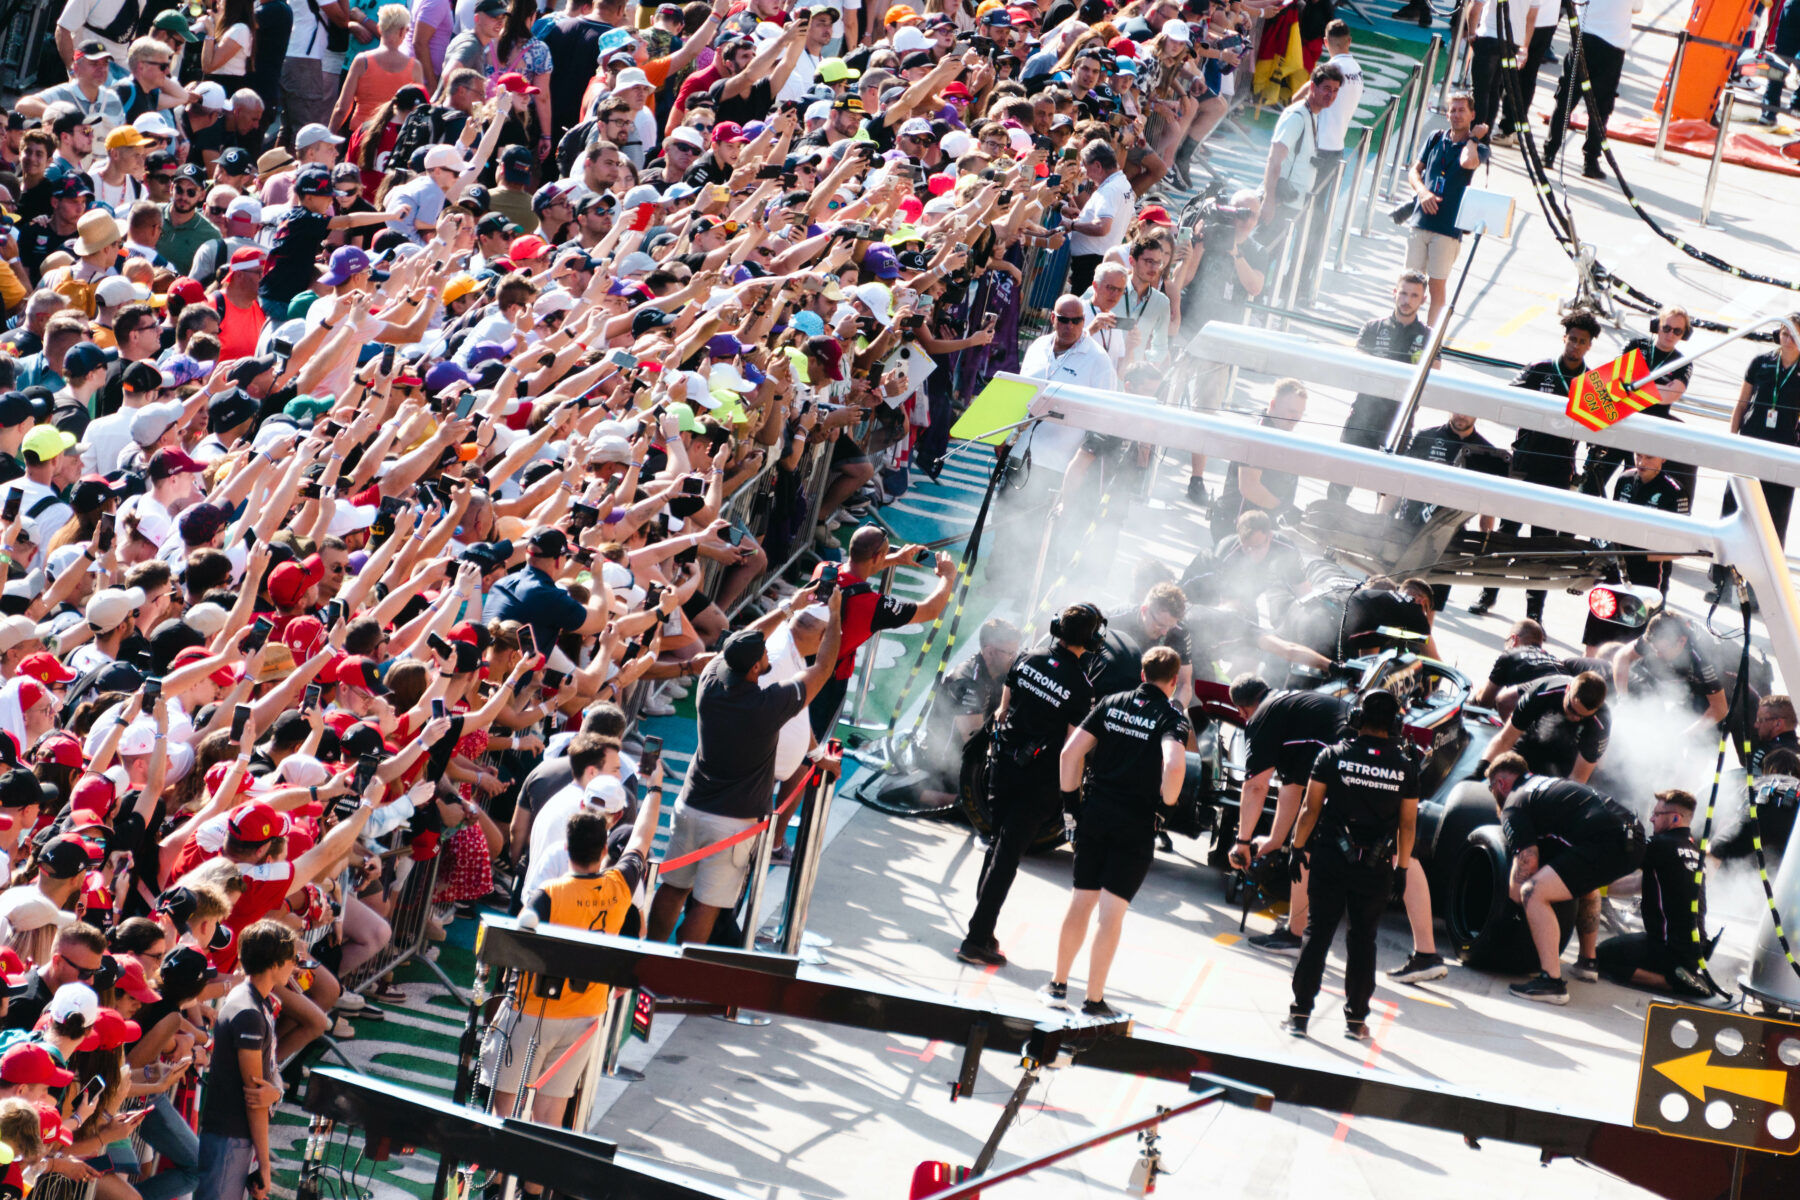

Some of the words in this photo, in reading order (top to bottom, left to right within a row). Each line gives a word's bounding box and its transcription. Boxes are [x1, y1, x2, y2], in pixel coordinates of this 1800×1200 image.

[1584, 392, 1600, 412] ON
[1588, 371, 1619, 421] BRAKES
[1016, 662, 1072, 701] PETRONAS
[1017, 677, 1062, 709] CROWDSTRIKE
[1337, 760, 1405, 781] PETRONAS
[1343, 775, 1401, 792] CROWDSTRIKE
